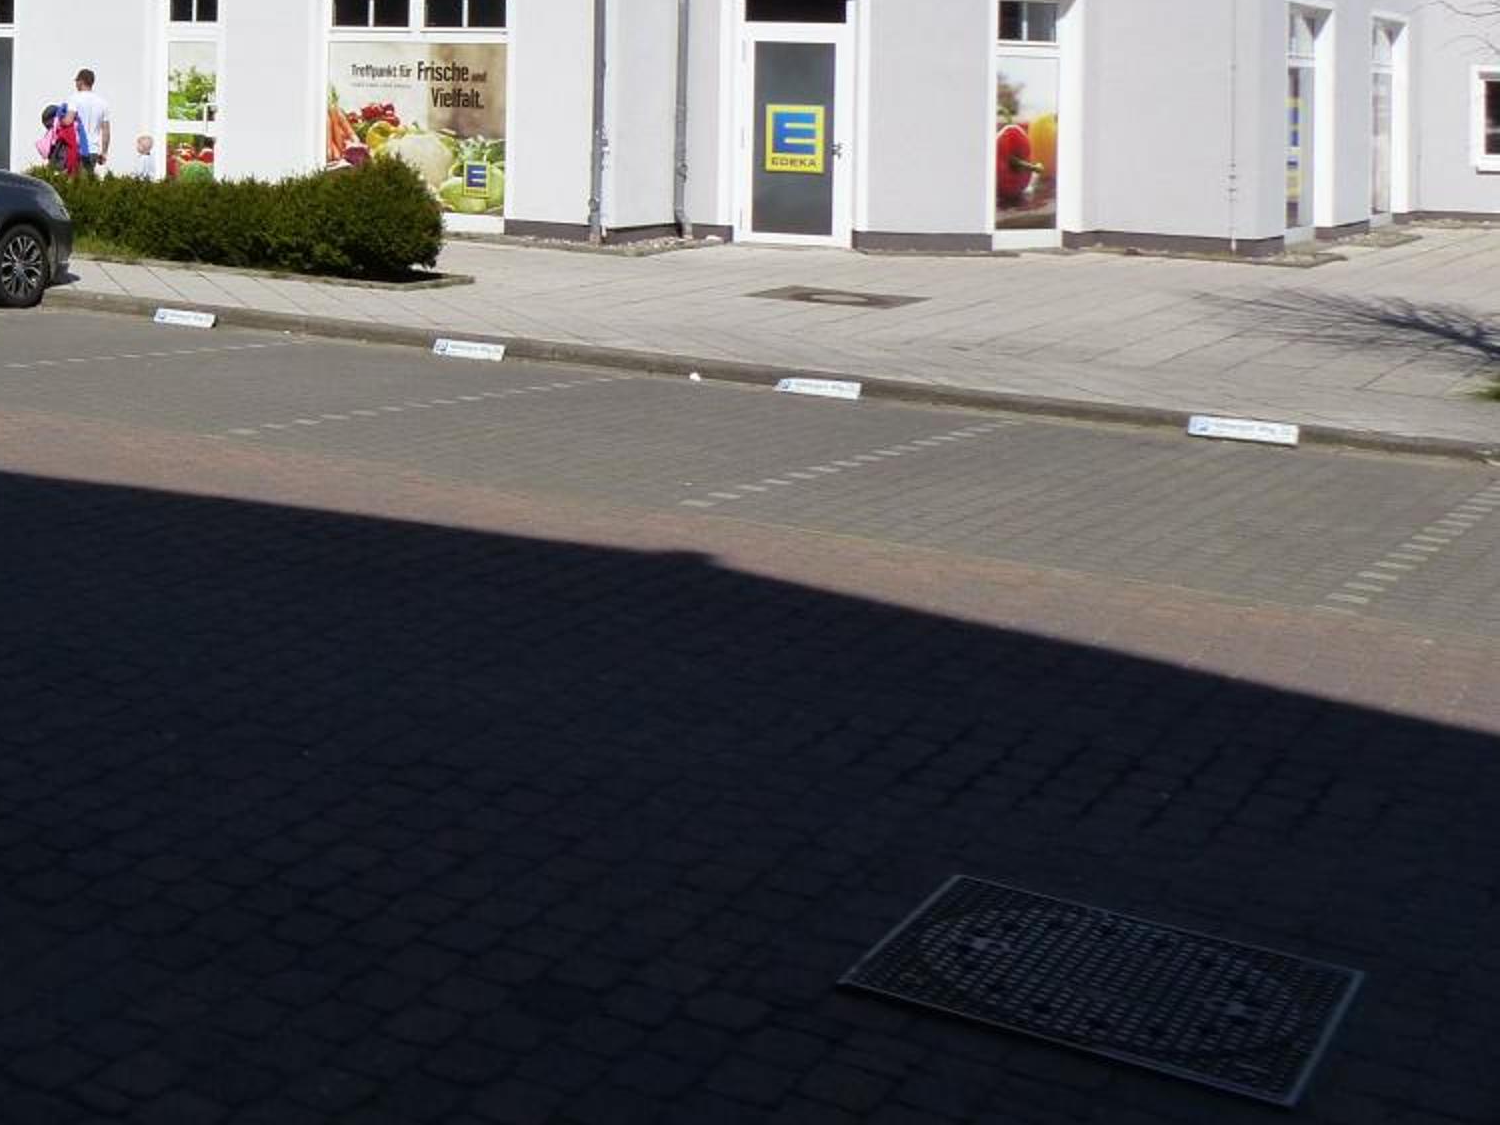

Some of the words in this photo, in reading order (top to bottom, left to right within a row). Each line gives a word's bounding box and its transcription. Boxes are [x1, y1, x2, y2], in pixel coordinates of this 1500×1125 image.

[351, 64, 397, 78] Treffpunkt
[400, 64, 412, 77] für
[417, 61, 469, 81] Frische
[431, 88, 485, 108] Vielfalt.
[773, 112, 816, 155] E
[771, 158, 817, 167] EDEKA
